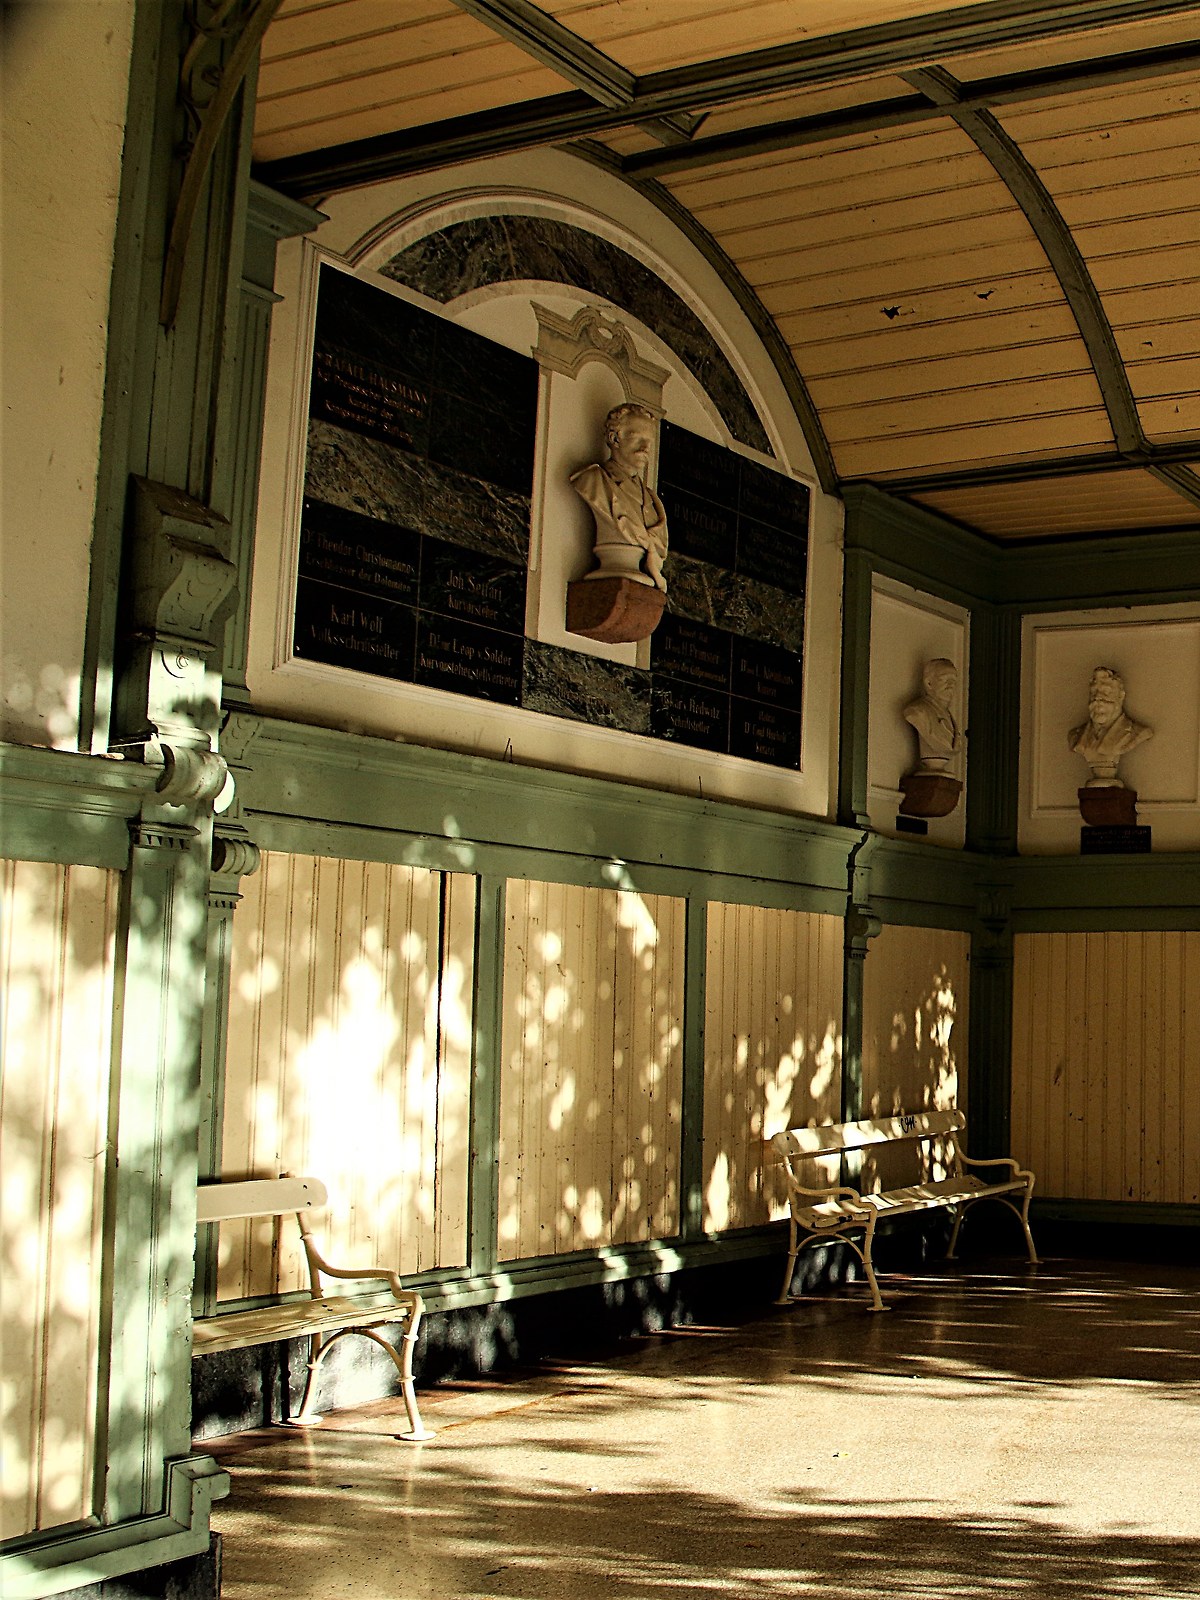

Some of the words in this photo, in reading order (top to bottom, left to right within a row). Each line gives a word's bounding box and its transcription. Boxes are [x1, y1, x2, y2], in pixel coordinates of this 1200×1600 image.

[324, 353, 365, 380] RAFAEL
[368, 371, 427, 405] HAUSMANN
[316, 531, 352, 556] Theodor
[374, 572, 411, 593] Dolomiten
[330, 603, 355, 627] Karl
